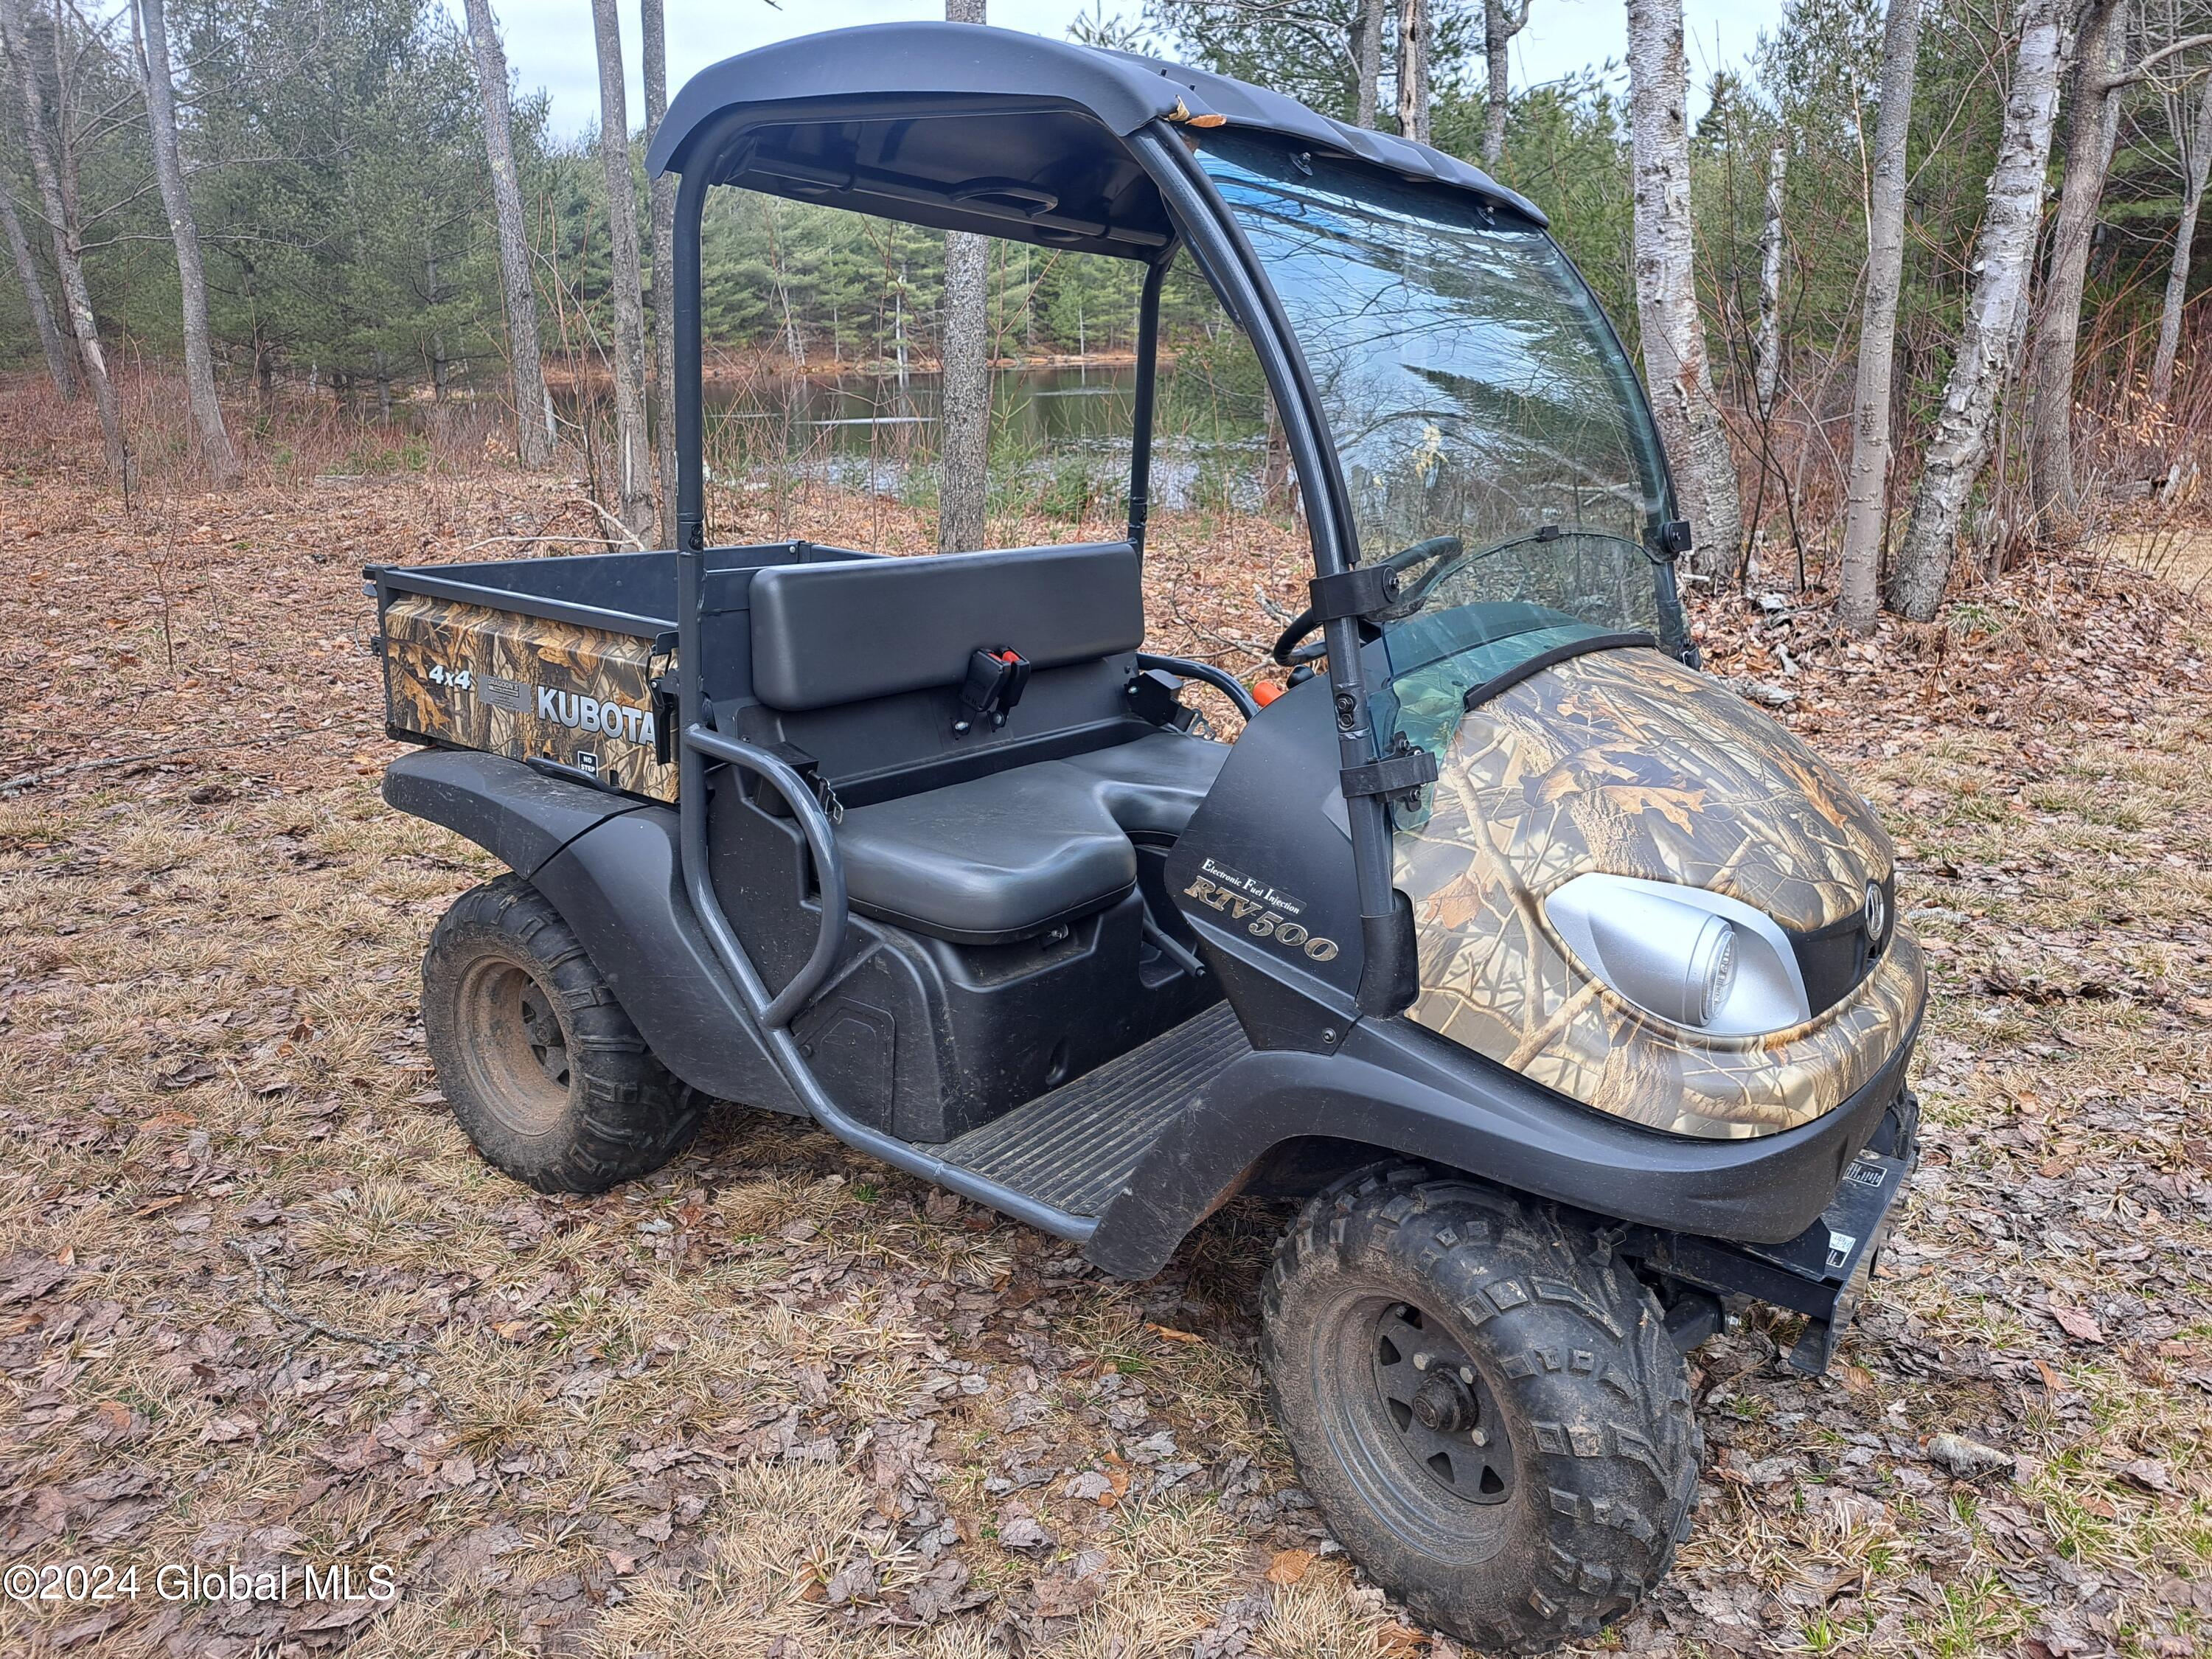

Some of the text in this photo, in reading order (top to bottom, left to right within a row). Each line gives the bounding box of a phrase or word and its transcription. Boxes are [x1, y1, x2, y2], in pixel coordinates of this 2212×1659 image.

[428, 664, 471, 690] 4x4
[537, 685, 656, 747] KUBOTA
[580, 763, 596, 773] STEP
[583, 756, 592, 764] NO
[1201, 858, 1301, 914] Electronic Fuel Injection
